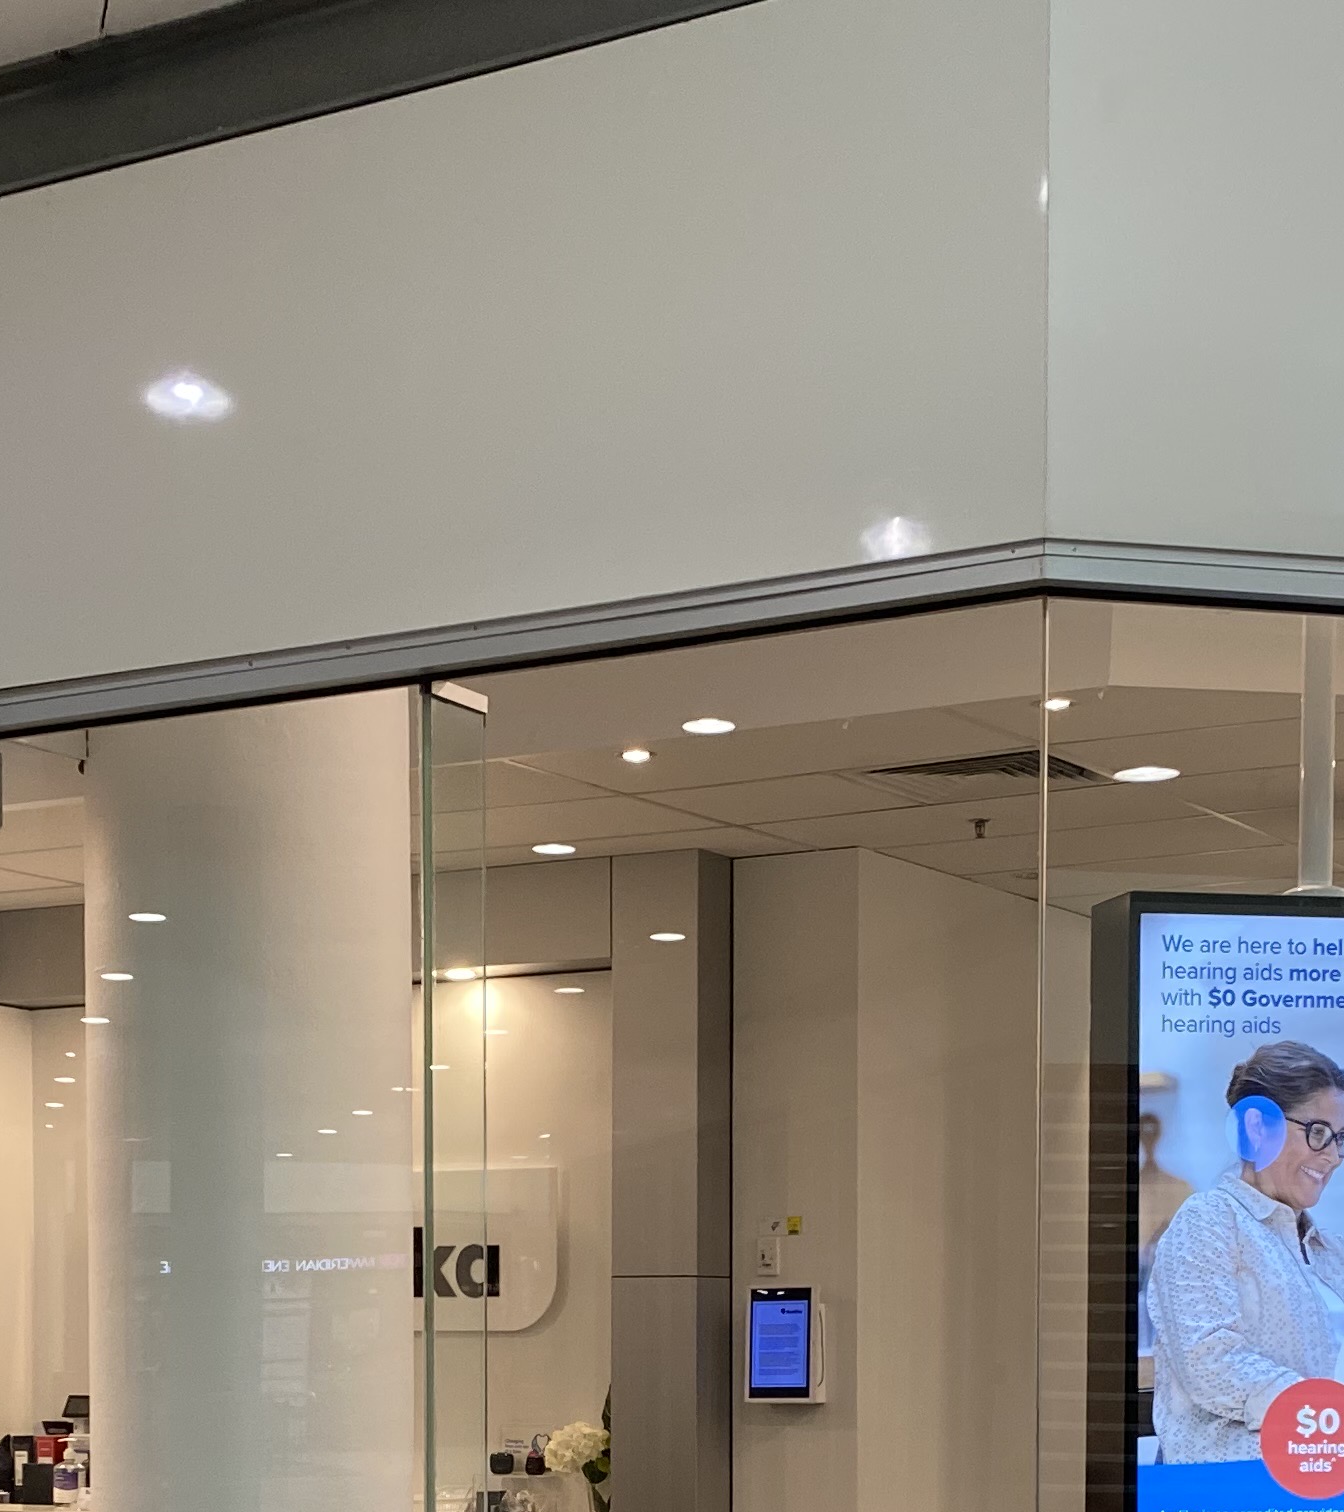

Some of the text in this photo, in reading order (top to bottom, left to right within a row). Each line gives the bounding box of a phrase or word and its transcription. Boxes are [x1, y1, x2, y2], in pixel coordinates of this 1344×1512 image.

[1161, 934, 1193, 953] We
[1199, 939, 1231, 954] are
[1237, 936, 1281, 955] here
[1287, 938, 1307, 956] to
[1161, 962, 1237, 985] hearing
[1243, 963, 1283, 982] aids
[1289, 967, 1341, 983] more
[1161, 988, 1202, 1006] with
[1208, 987, 1236, 1008] $0
[1161, 1014, 1281, 1038] hearing aids
[1296, 1405, 1341, 1438] $0
